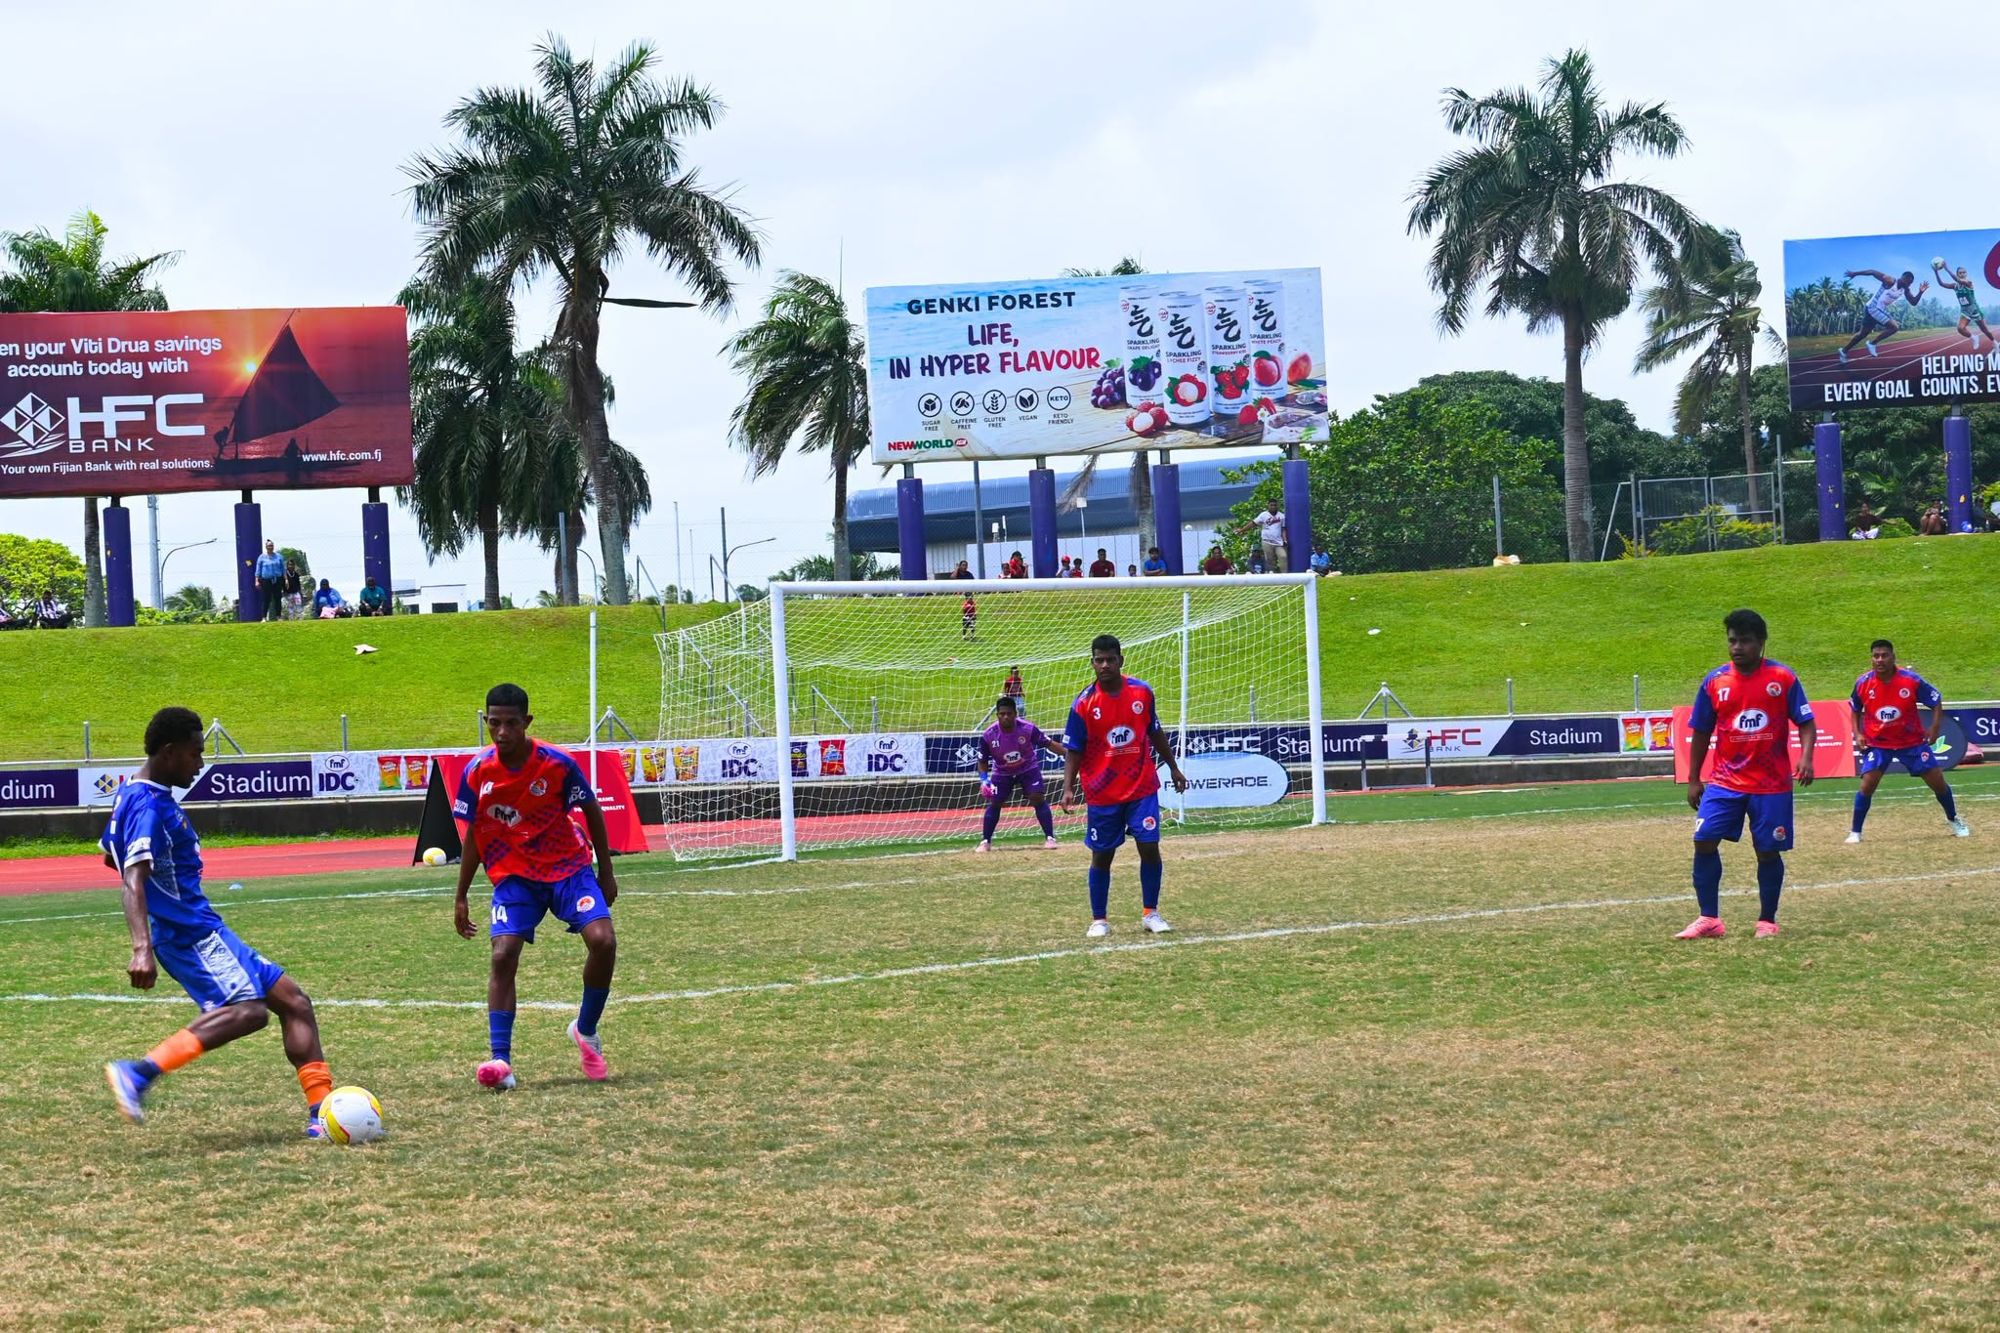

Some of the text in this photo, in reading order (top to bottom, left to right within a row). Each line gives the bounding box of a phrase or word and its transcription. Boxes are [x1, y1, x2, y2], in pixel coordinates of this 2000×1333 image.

[907, 291, 1076, 315] GENKI FOREST
[968, 323, 1019, 347] LIFE,
[25, 342, 66, 360] your
[71, 338, 103, 354] Viti
[108, 337, 149, 354] Drua
[154, 336, 223, 355] savings
[1166, 350, 1202, 358] SPARKLING
[1212, 343, 1247, 351] SPARKLING
[7, 357, 188, 379] account today with
[889, 347, 1101, 379] IN HYPER FLAVOUR
[1922, 354, 1984, 375] HELPING
[1824, 382, 1872, 402] EVERY
[1875, 380, 1914, 399] GOAL
[1920, 376, 1983, 396] COUNTS.
[67, 393, 206, 439] HFC
[69, 438, 155, 453] BANK
[302, 449, 382, 462] www.hfc.com.fj
[1, 458, 214, 475] Your own Fijian Bank with real solutions.
[1717, 687, 1731, 701] 17
[1869, 690, 1876, 699] 2
[1092, 707, 1102, 720] 3
[1740, 713, 1764, 729] fmf
[1880, 710, 1897, 720] fmf
[879, 740, 895, 749] fmf
[991, 740, 1000, 748] 21
[1211, 736, 1262, 752] HFC
[1277, 733, 1362, 755] Staium
[1427, 728, 1481, 746] HFC
[1529, 728, 1603, 747] Stadium
[328, 758, 346, 769] fmf
[868, 753, 904, 772] IDC
[1868, 752, 1875, 761] 2
[721, 758, 758, 778] IDC
[1, 779, 55, 800] dium
[210, 770, 310, 795] Stadium
[318, 772, 355, 792] IDC
[1090, 828, 1098, 841] 3
[491, 905, 508, 925] 14
